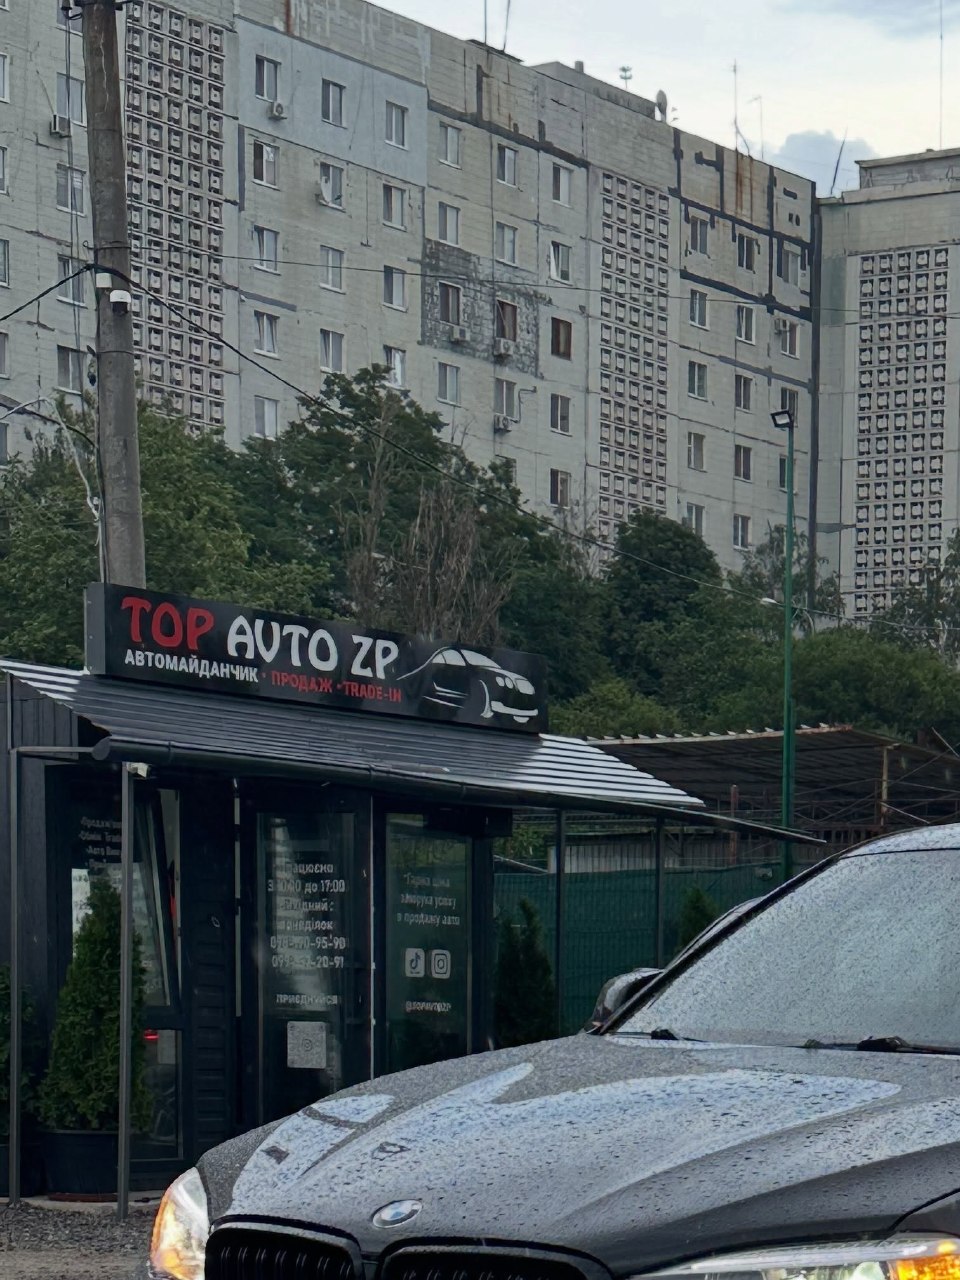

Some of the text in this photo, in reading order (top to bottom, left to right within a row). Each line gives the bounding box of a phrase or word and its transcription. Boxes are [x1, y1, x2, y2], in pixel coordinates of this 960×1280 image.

[121, 596, 215, 650] TOP
[351, 633, 400, 680] ZP
[125, 648, 402, 703] АВТОМАЙДАНЧИК ПРОДАЖ TRADE-IN
[304, 882, 318, 895] до
[320, 879, 347, 893] 17:00
